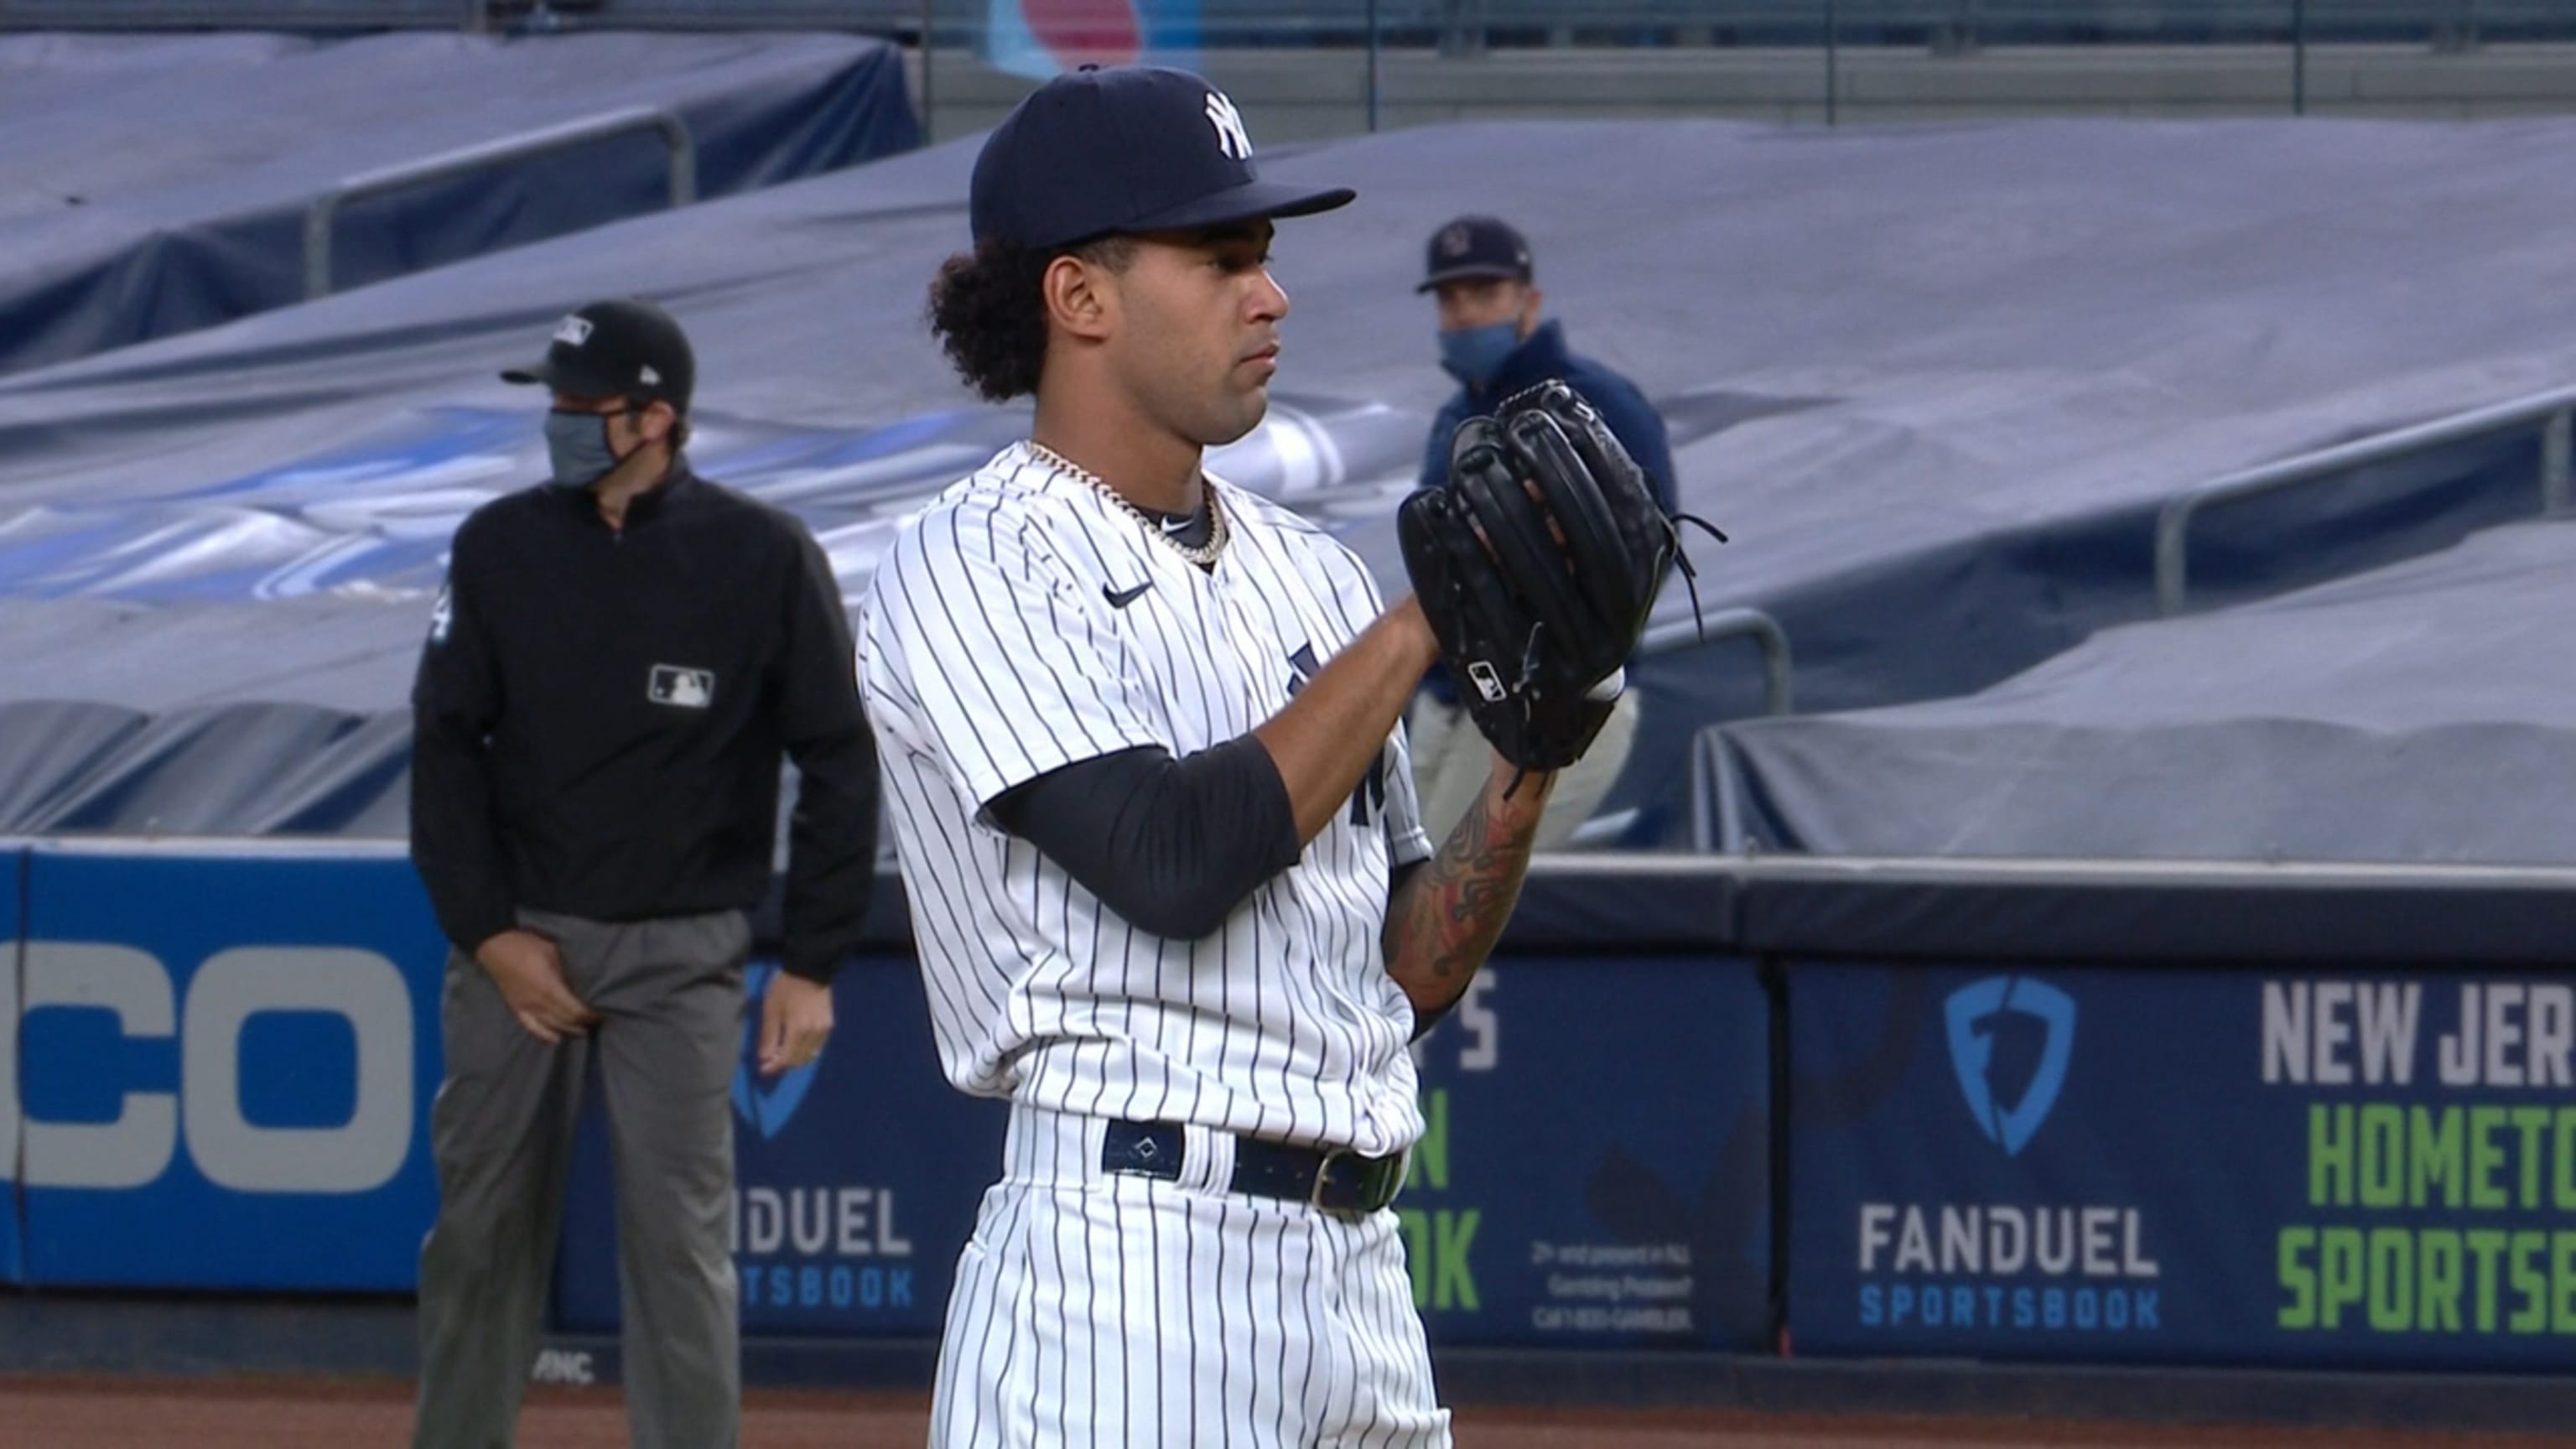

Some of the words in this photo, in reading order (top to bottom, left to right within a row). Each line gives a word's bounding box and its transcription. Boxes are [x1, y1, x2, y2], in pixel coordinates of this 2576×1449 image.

[1205, 91, 1253, 159] NY
[0, 939, 415, 1195] CO
[2262, 981, 2423, 1085] NEW
[2438, 983, 2576, 1088] JER
[1858, 1203, 2159, 1277] FANDUEL
[1858, 1283, 2160, 1329] SPORTSBOOK
